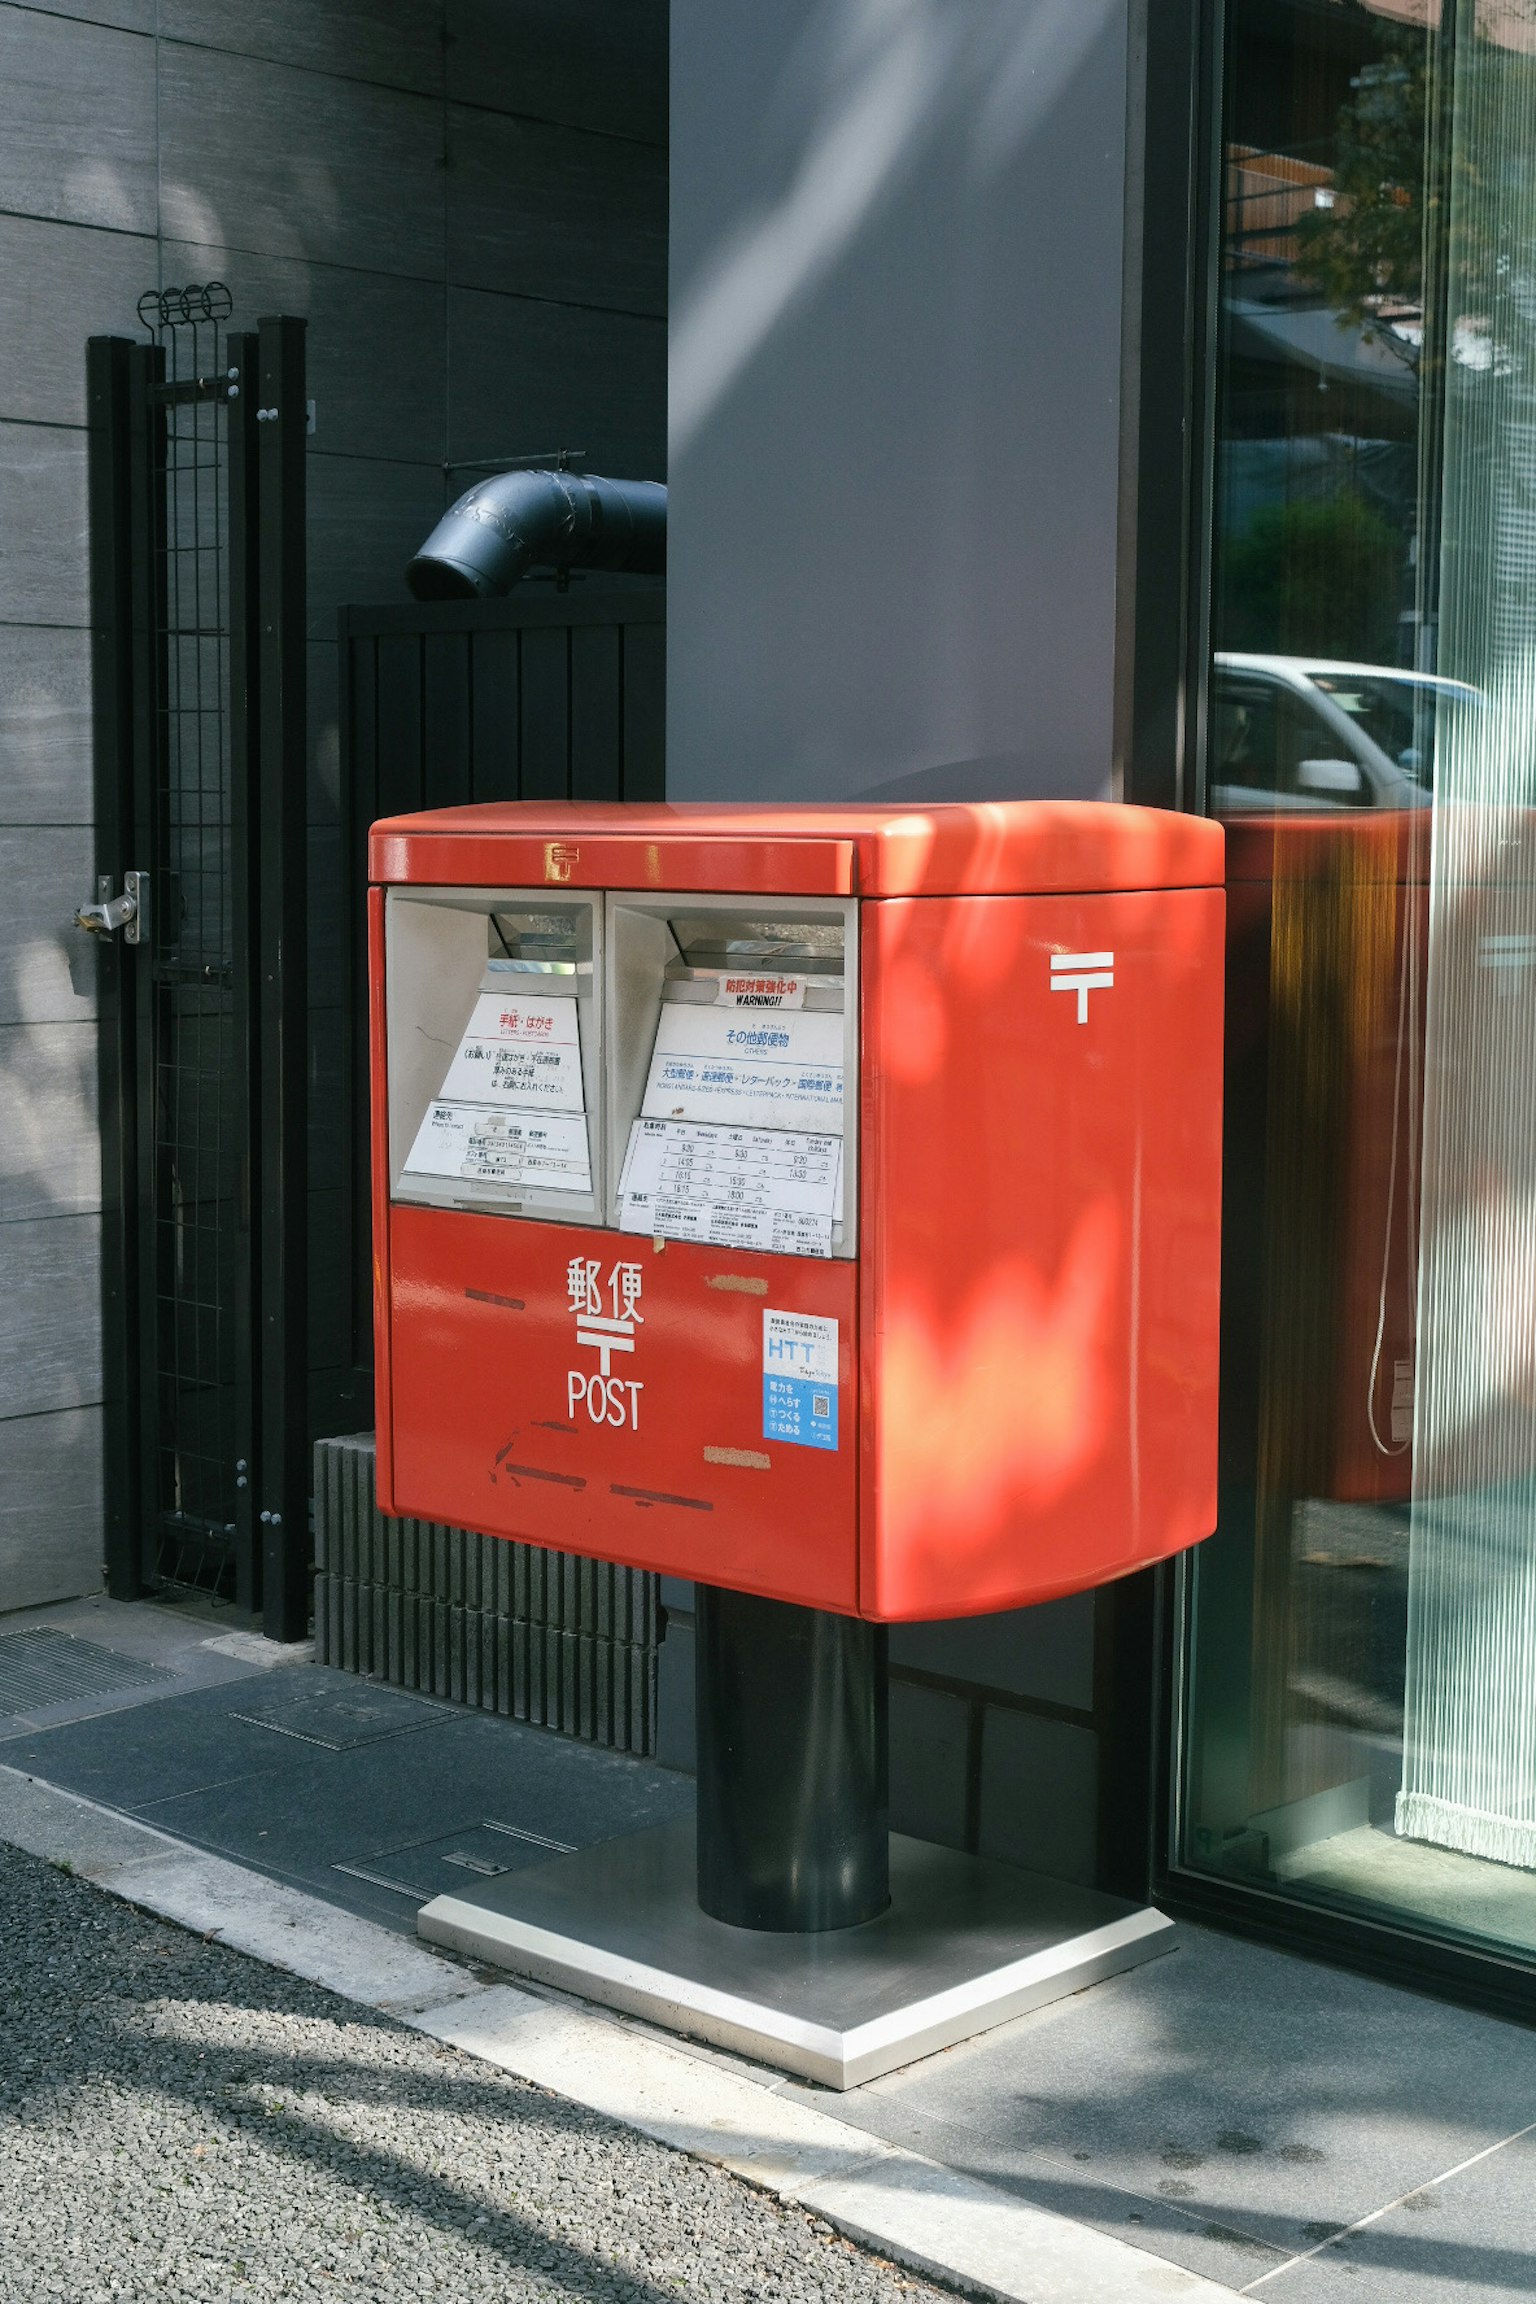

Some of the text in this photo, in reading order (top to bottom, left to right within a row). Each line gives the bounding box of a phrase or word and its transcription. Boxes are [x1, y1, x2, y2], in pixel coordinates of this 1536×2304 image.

[725, 978, 797, 994] 防犯対策強化中
[736, 995, 782, 1007] WARNING!!
[726, 1030, 790, 1047] その他郵便物
[566, 1256, 644, 1323] 郵便
[769, 1337, 815, 1363] HTT
[769, 1381, 794, 1395] 電力を
[567, 1370, 644, 1431] POST
